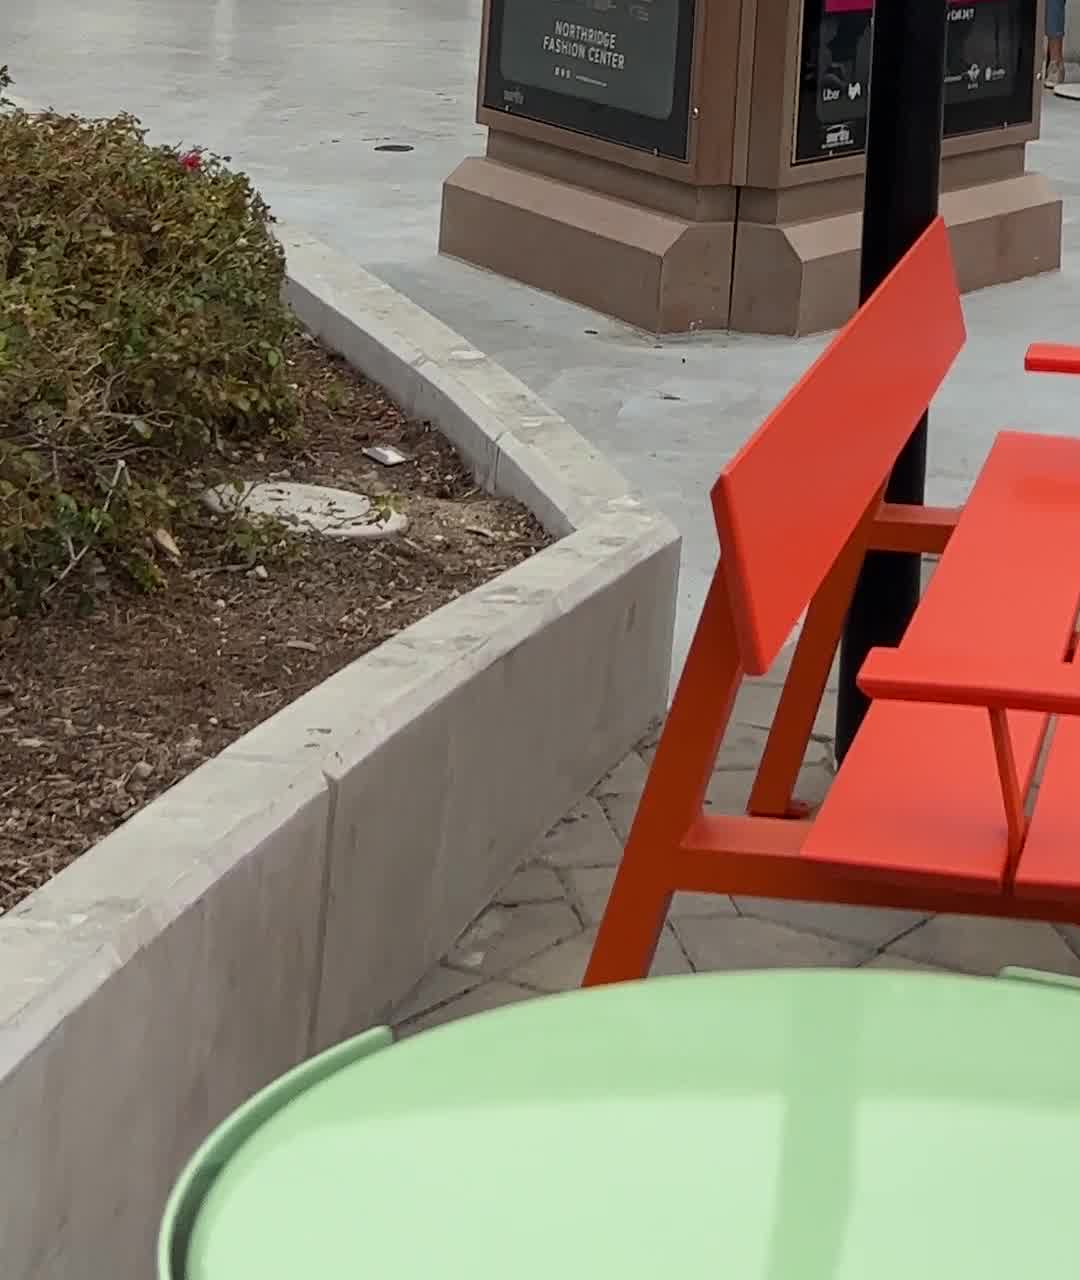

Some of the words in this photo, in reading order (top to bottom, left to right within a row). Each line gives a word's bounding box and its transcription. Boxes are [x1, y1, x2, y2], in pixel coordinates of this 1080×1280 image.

[554, 20, 617, 49] NORTHRIDGE
[543, 35, 586, 60] FASHION
[588, 47, 625, 70] CENTER
